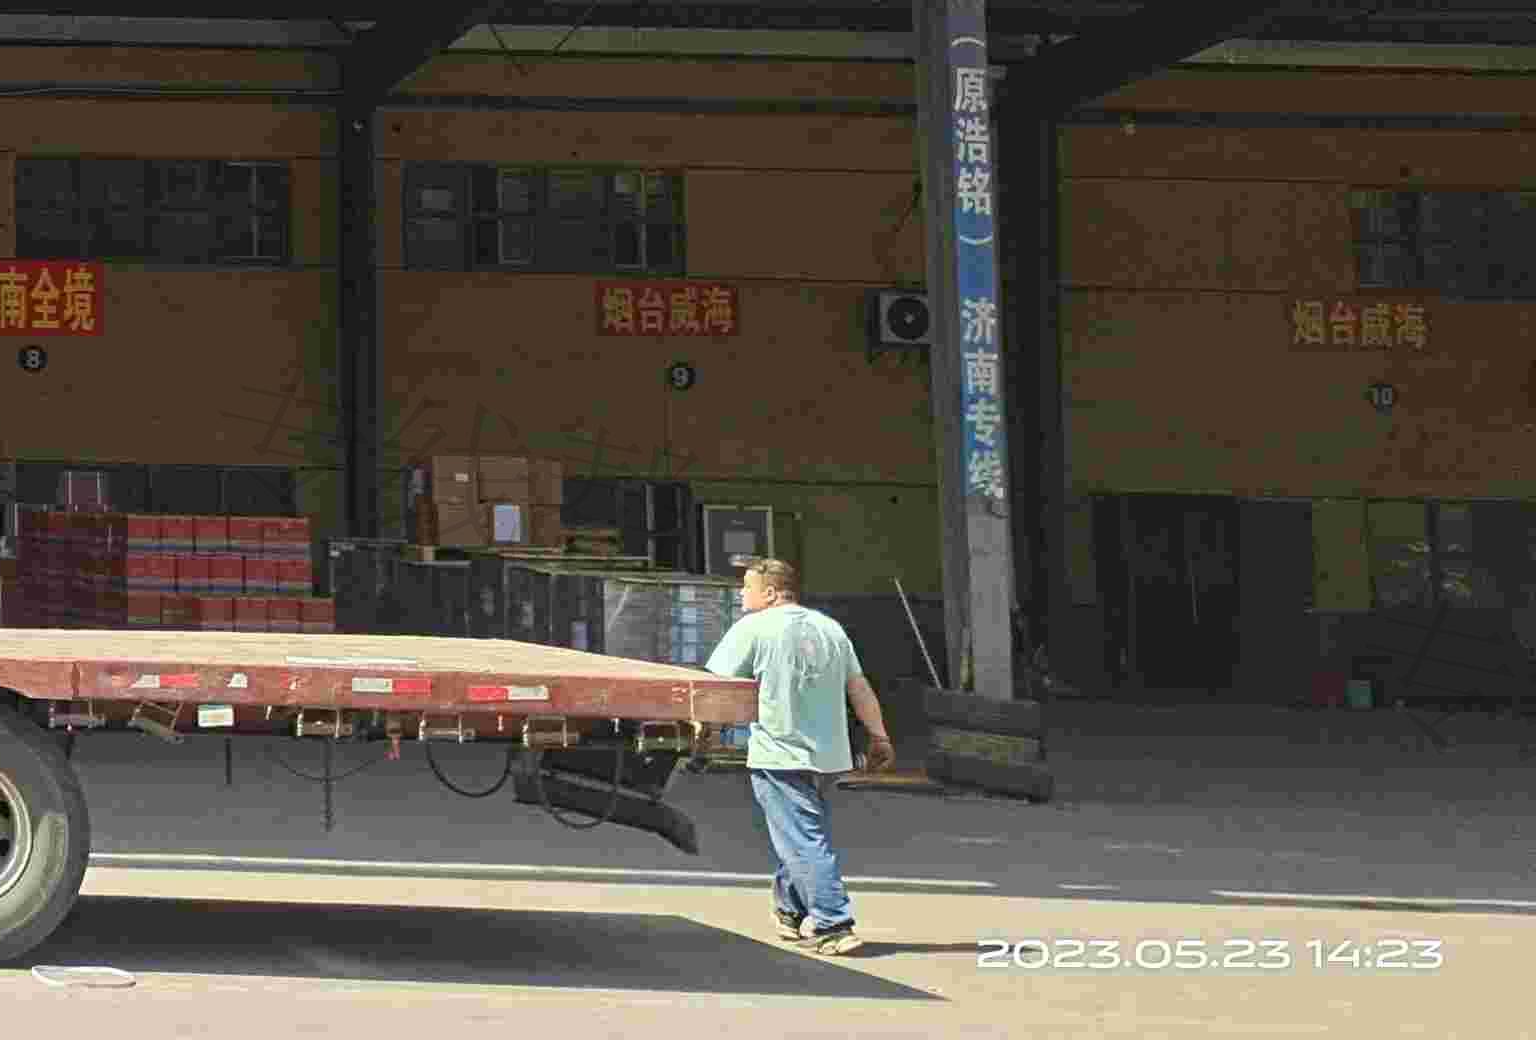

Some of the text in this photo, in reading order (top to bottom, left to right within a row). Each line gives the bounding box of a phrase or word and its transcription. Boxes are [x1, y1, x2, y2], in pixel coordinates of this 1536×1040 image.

[602, 286, 733, 335] 烟台威海
[1292, 299, 1427, 351] 烟台威海
